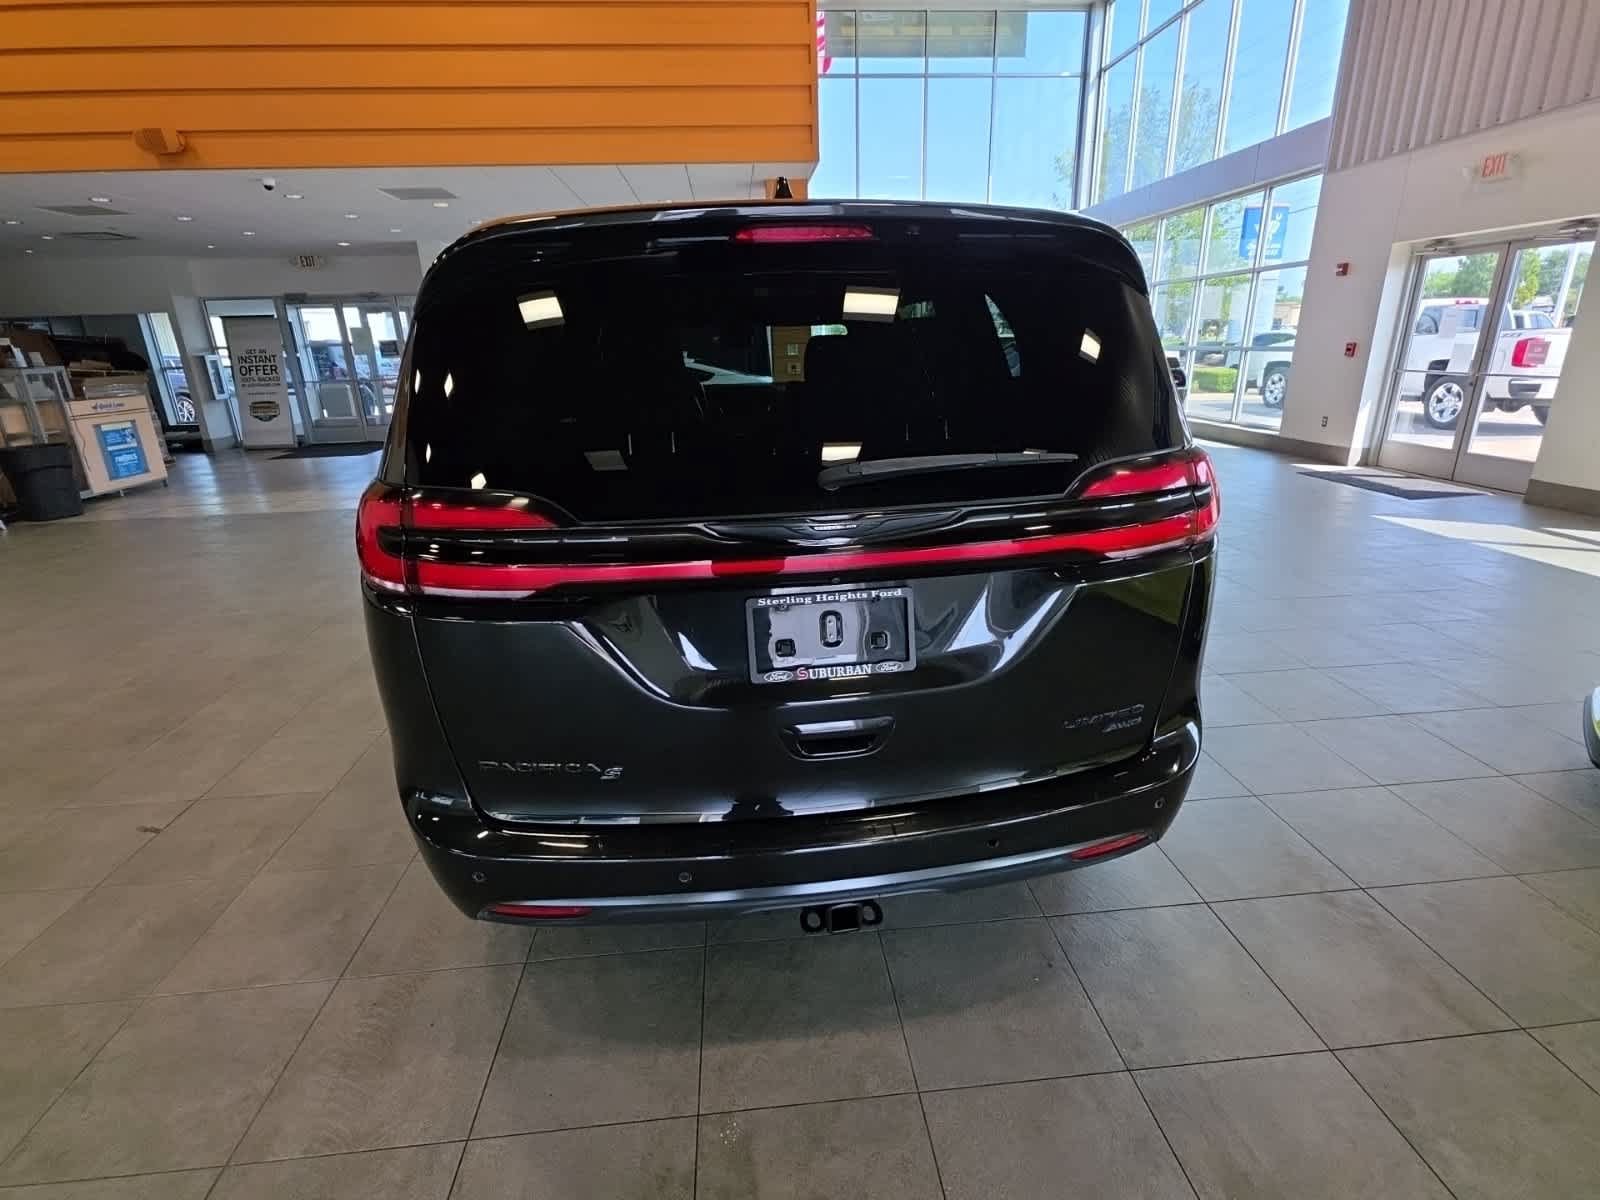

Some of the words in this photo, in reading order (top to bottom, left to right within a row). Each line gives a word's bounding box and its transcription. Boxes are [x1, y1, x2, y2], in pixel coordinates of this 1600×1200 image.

[1481, 152, 1508, 177] EXIT
[300, 255, 316, 267] EXIT
[238, 354, 277, 364] INSTANT
[240, 365, 279, 376] OFFER
[757, 595, 813, 606] Sterling
[816, 591, 868, 603] Heights
[871, 588, 902, 599] Ford
[796, 664, 873, 681] SUBURBAN
[878, 662, 901, 672] Ford
[767, 672, 791, 682] Ford
